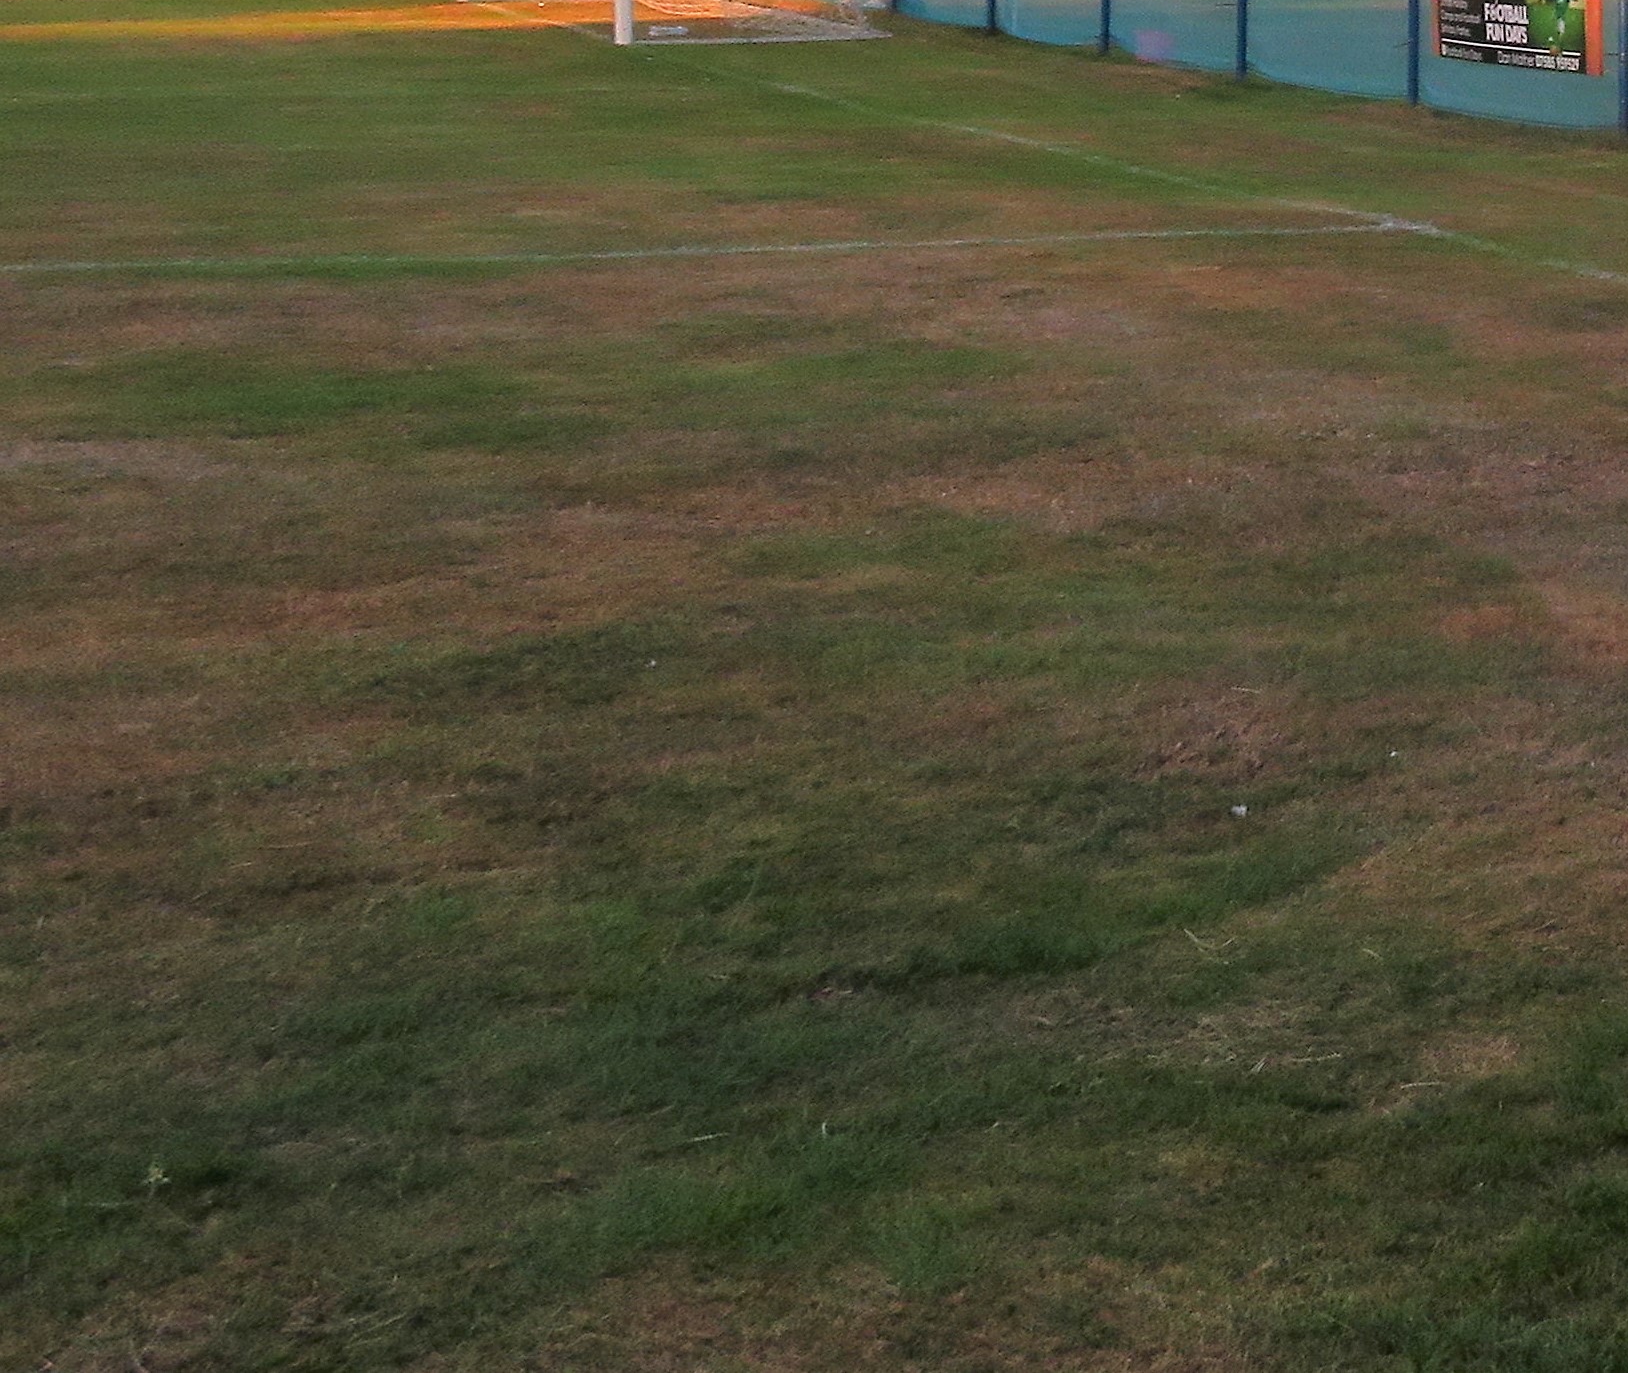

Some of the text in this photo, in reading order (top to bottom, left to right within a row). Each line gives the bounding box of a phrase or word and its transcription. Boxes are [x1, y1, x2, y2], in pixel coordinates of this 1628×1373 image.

[1484, 2, 1529, 25] FOOTBALL
[1485, 23, 1504, 42] FUN
[1505, 24, 1528, 44] DAYS
